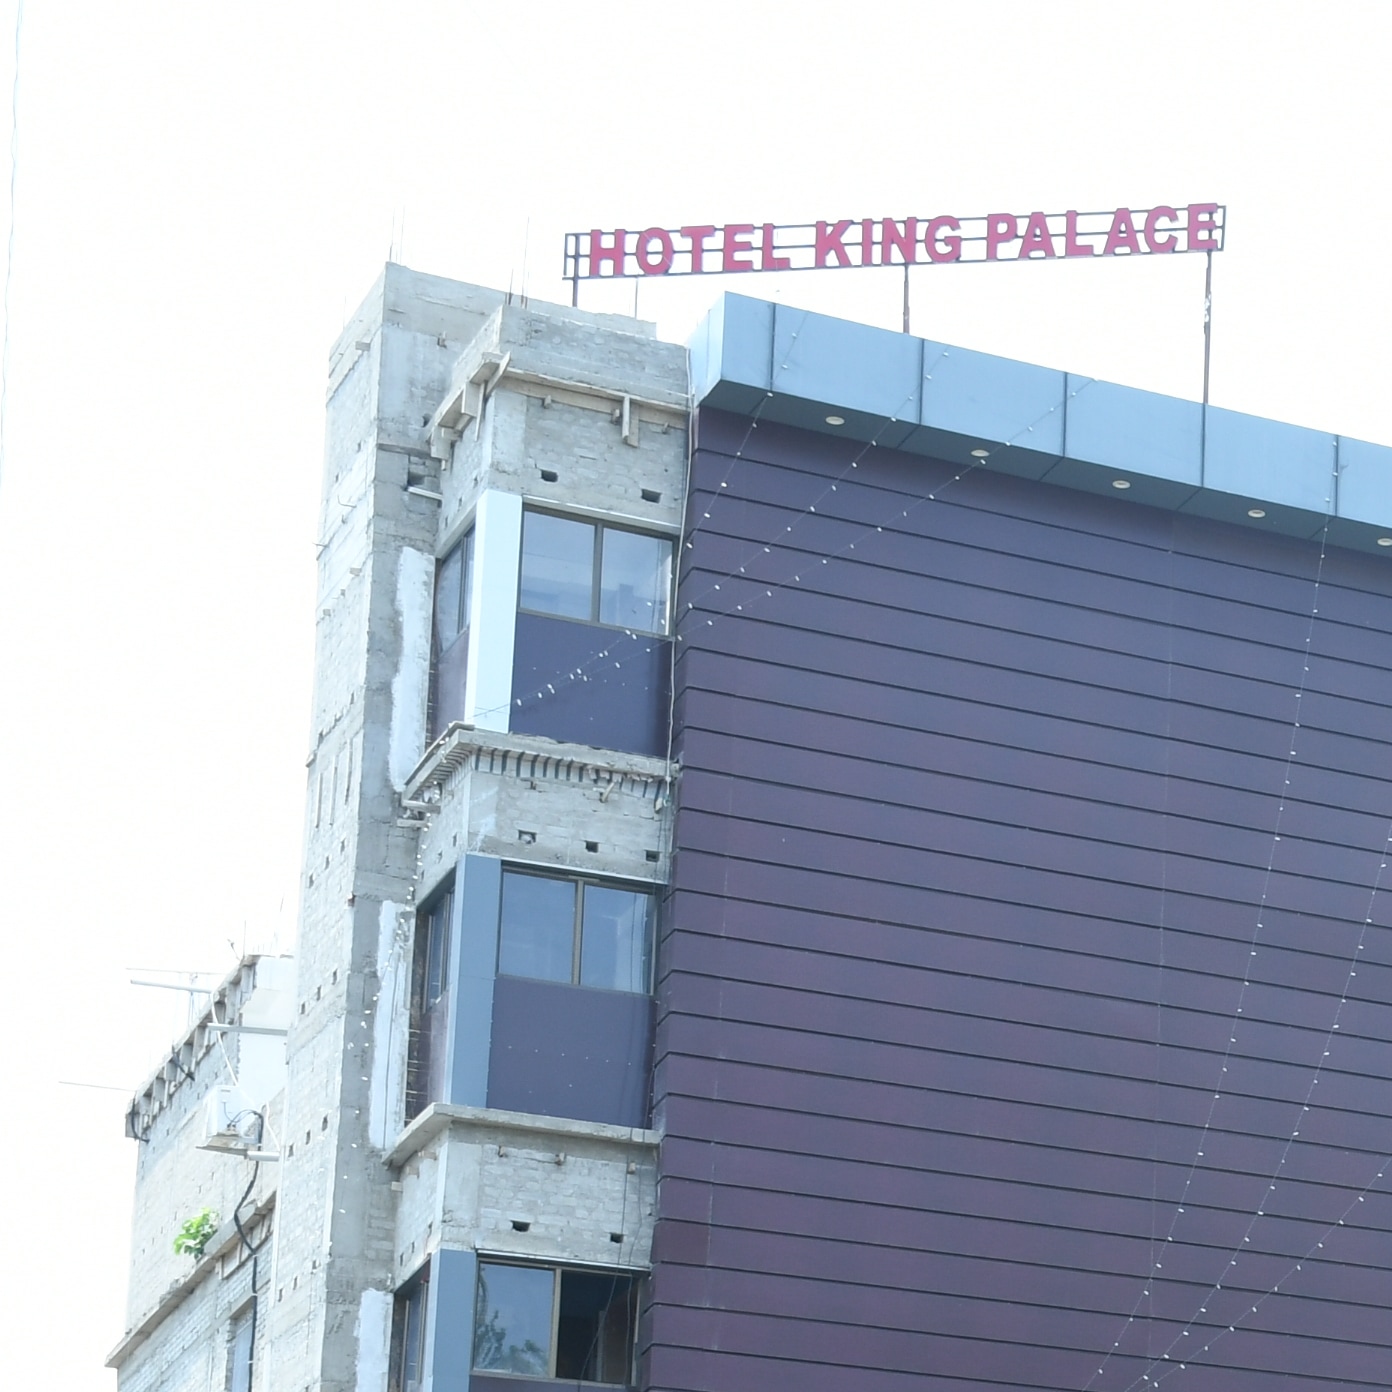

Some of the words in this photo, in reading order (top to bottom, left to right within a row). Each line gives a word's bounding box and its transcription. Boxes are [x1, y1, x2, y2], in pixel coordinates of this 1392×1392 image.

[589, 223, 791, 277] HOTEL
[814, 216, 962, 268] KING
[987, 203, 1219, 261] PALACE
